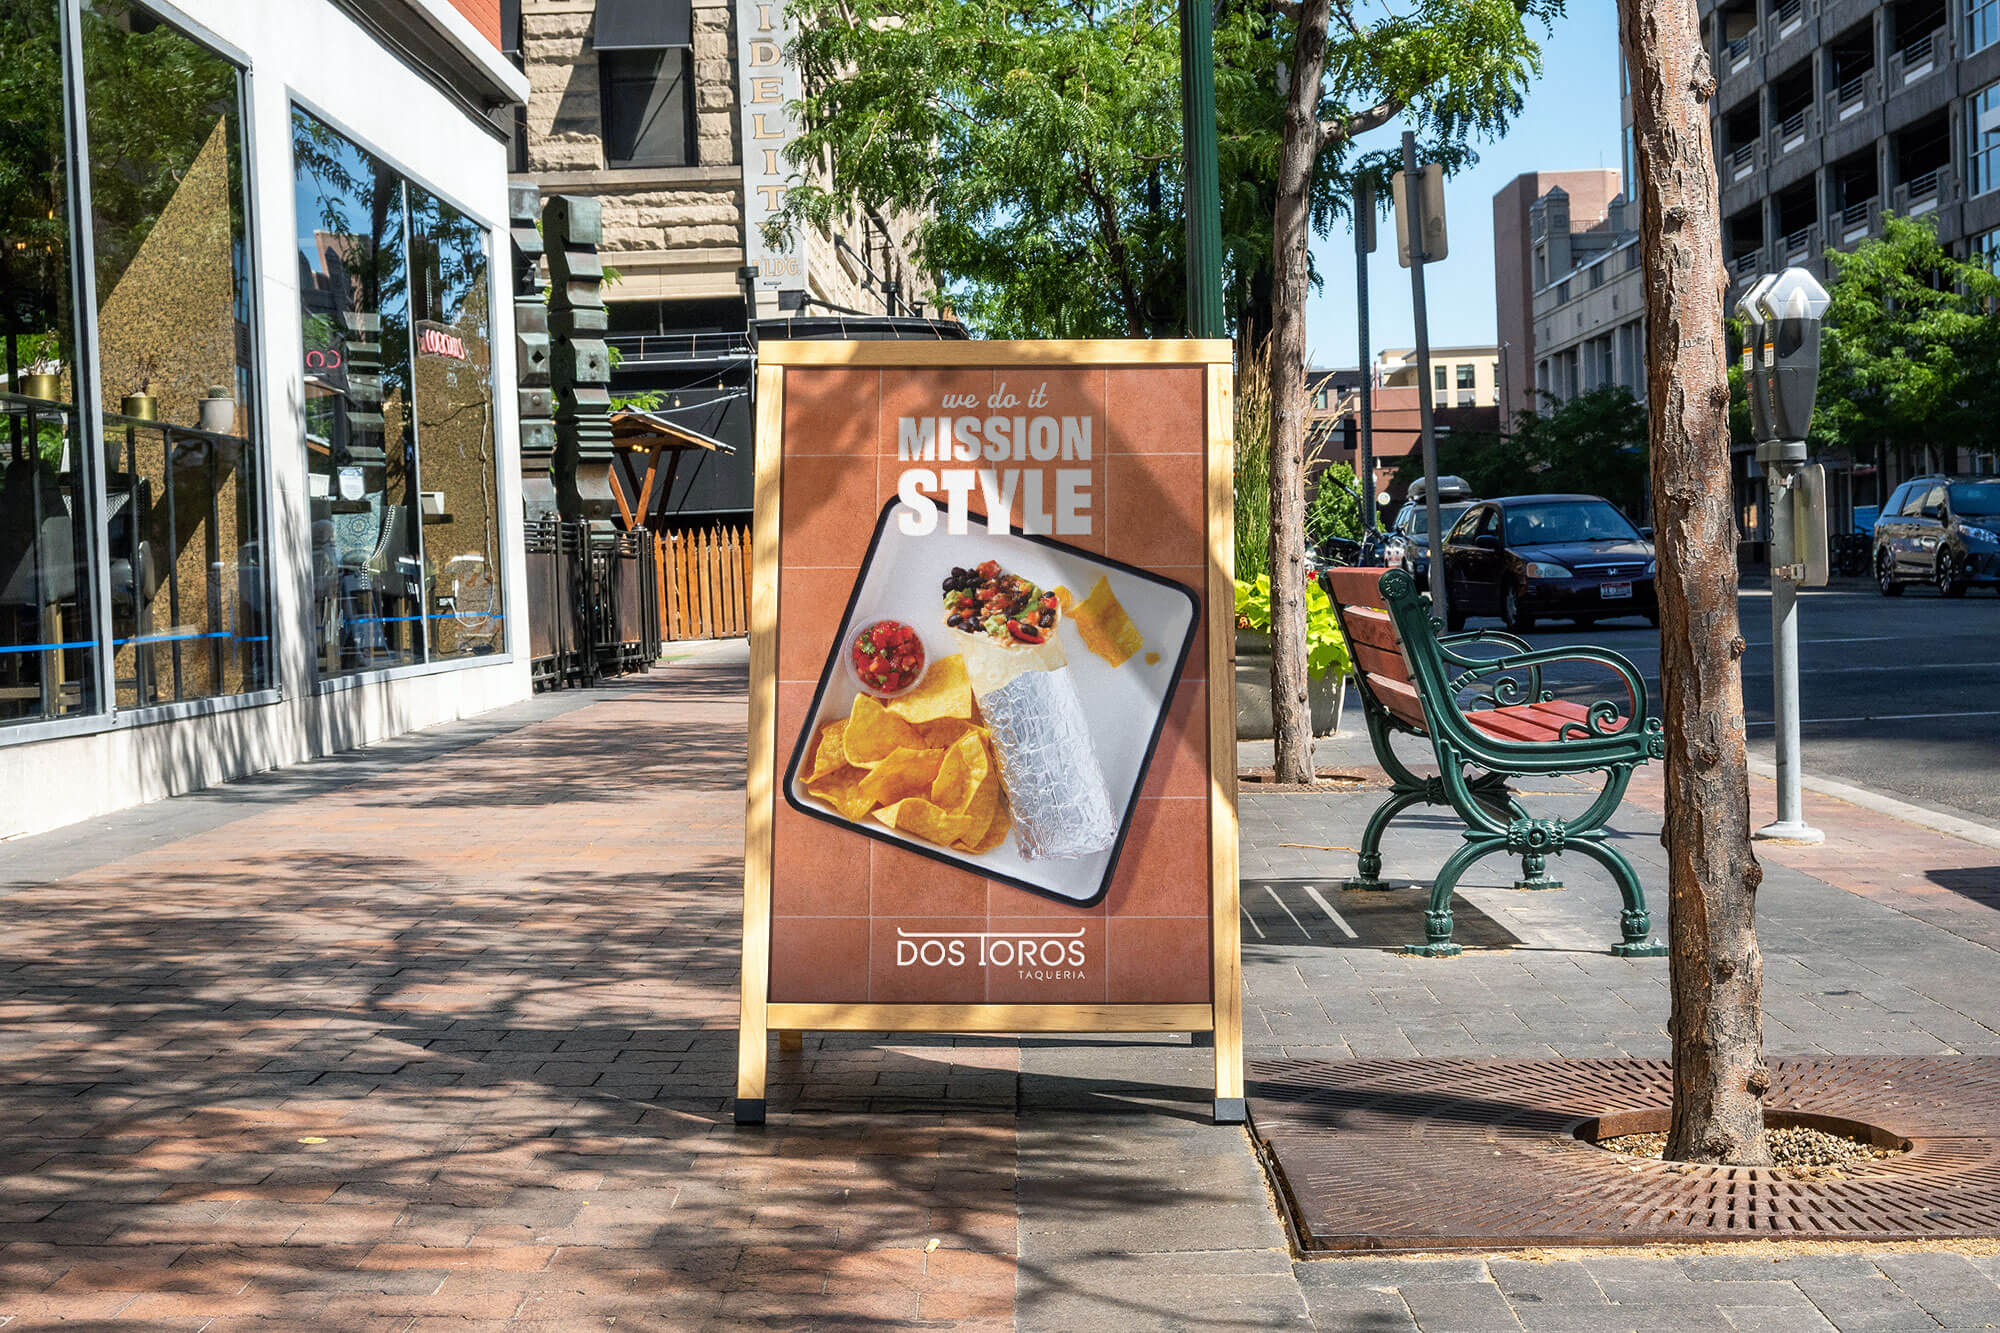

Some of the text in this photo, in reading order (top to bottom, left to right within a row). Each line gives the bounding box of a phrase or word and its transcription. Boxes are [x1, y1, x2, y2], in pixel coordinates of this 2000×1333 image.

[942, 382, 1048, 409] we do it
[898, 416, 1092, 461] MISSION
[898, 469, 1092, 536] STYLE
[897, 930, 1086, 967] DOS TOROS
[1018, 970, 1085, 981] TAQUERIA
